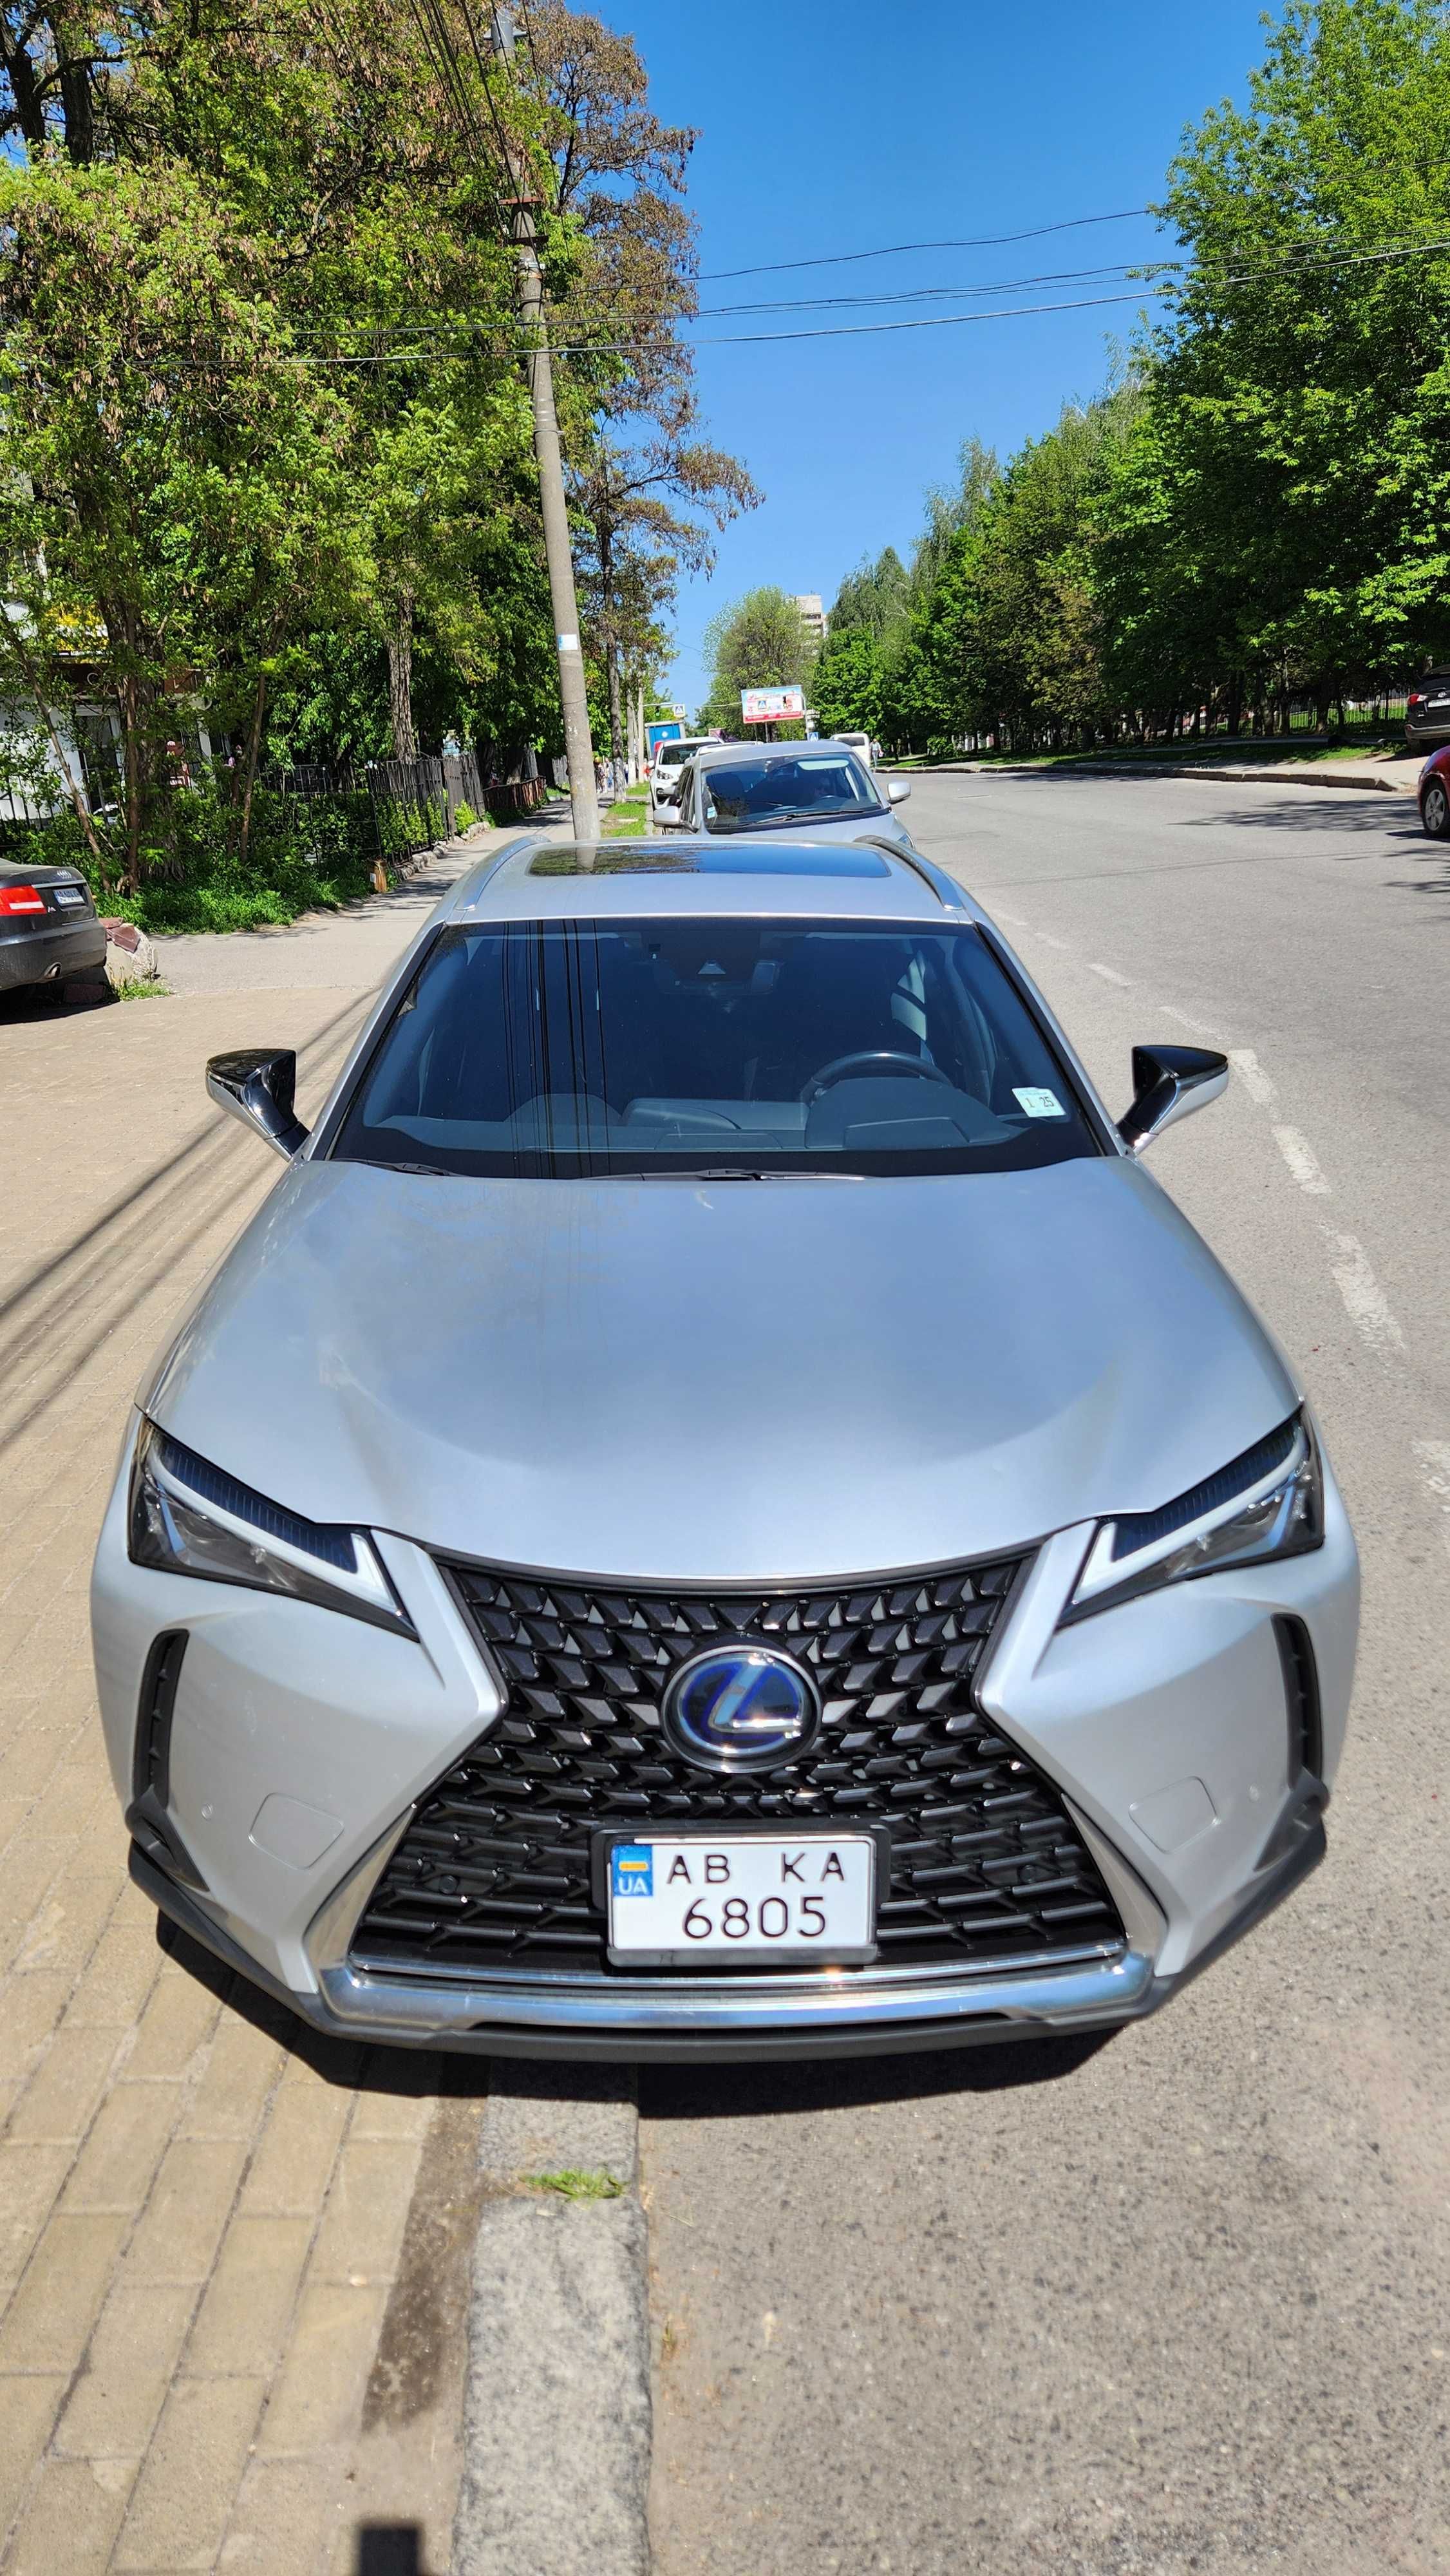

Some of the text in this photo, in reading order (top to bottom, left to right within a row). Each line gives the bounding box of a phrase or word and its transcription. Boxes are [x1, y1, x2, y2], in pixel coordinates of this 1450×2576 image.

[1039, 1096, 1055, 1108] 25
[667, 1852, 845, 1884] AB KA
[619, 1875, 648, 1895] UA
[683, 1896, 826, 1939] 6805
